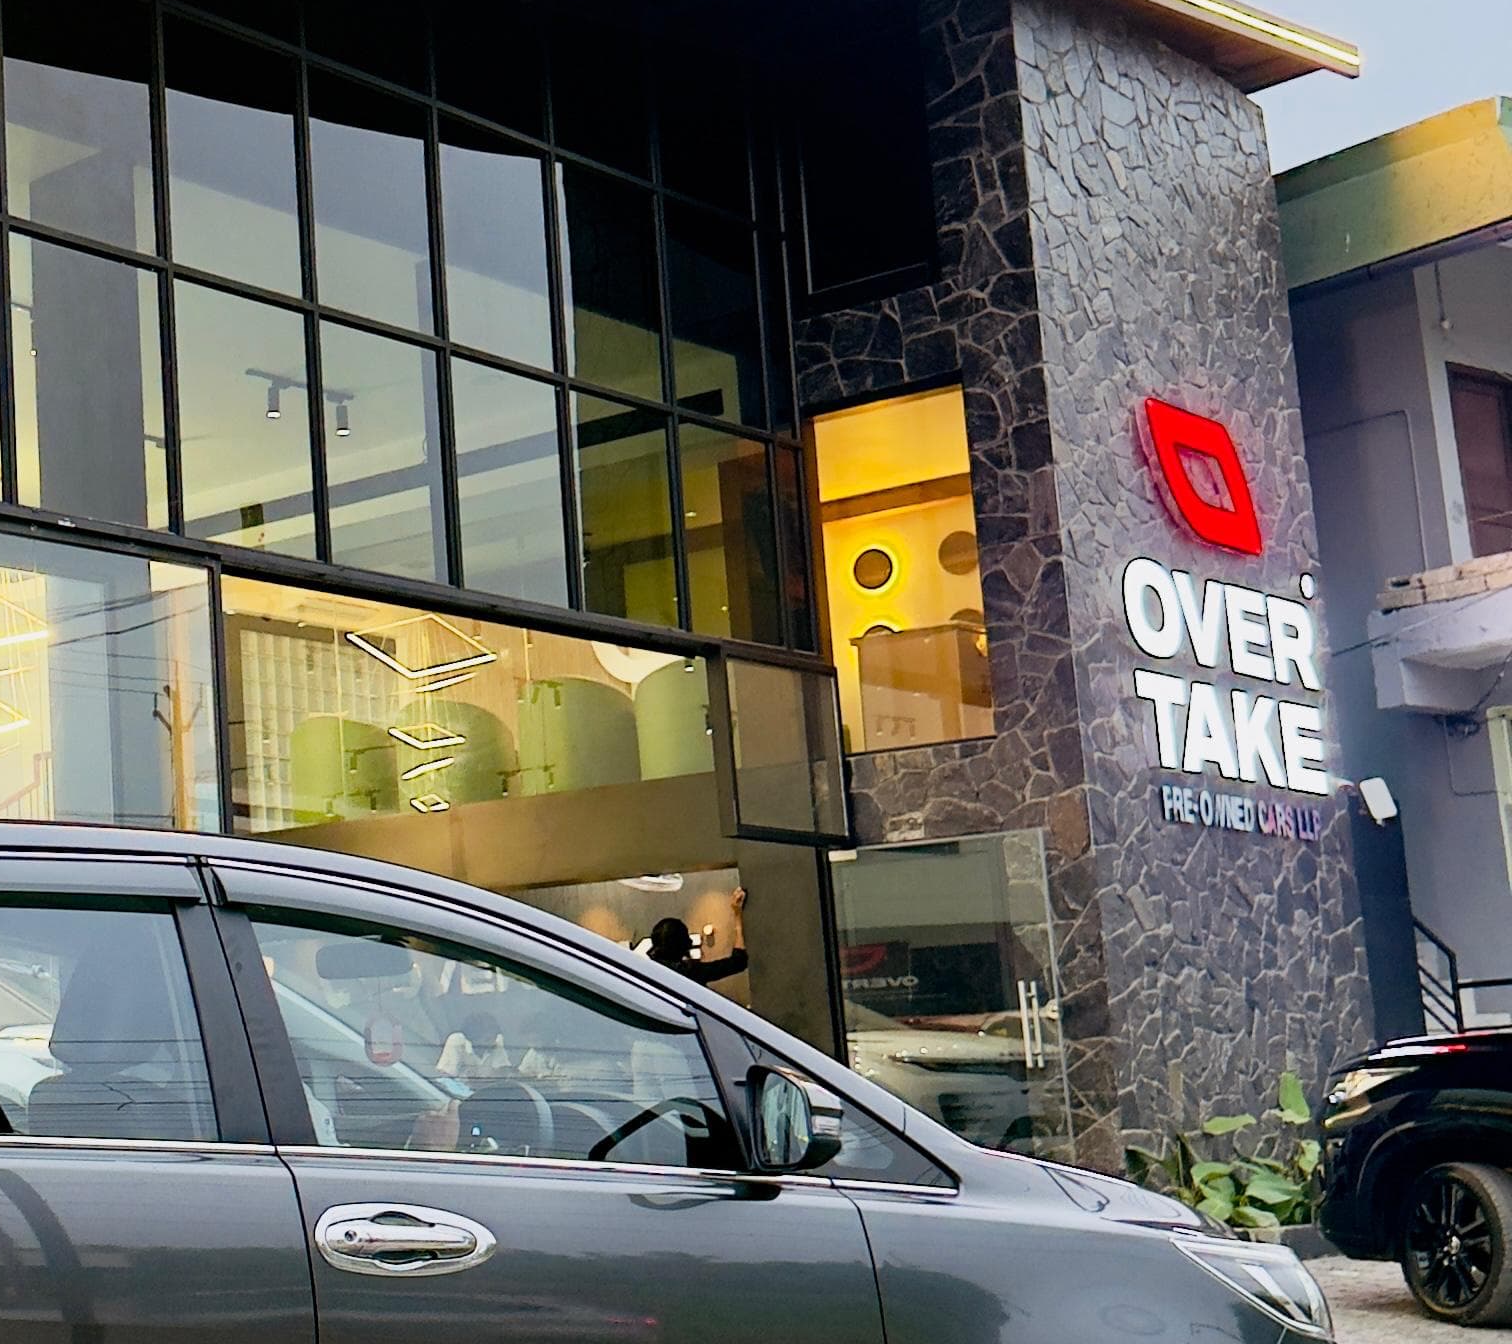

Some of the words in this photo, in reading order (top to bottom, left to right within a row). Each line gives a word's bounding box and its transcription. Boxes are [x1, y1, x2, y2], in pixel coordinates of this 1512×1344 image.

[1122, 556, 1320, 691] OVER
[1134, 668, 1329, 796] TAKE
[1161, 785, 1256, 833] PRE-OWNED
[1257, 799, 1296, 840] CARS
[1296, 807, 1321, 842] LLP
